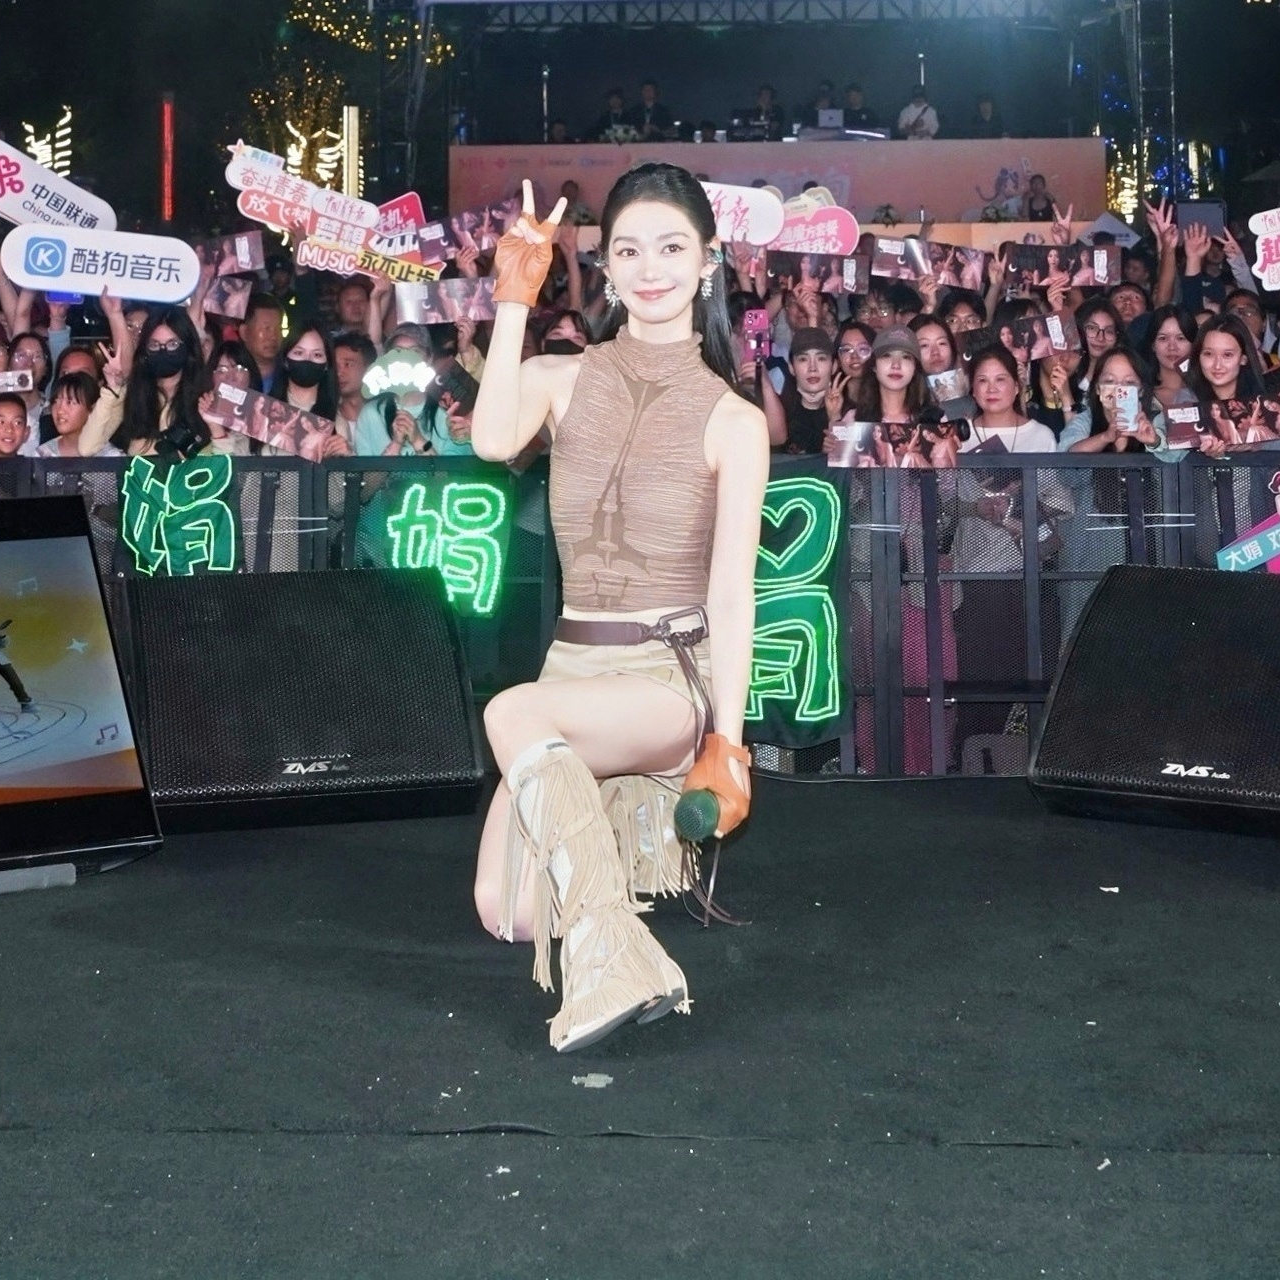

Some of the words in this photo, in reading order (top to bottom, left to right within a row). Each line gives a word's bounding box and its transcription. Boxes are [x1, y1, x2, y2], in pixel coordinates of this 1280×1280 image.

[240, 166, 310, 203] 奋斗青春
[31, 183, 100, 230] 中国联通
[70, 246, 182, 284] 酷狗音乐
[300, 245, 358, 272] MUSIC
